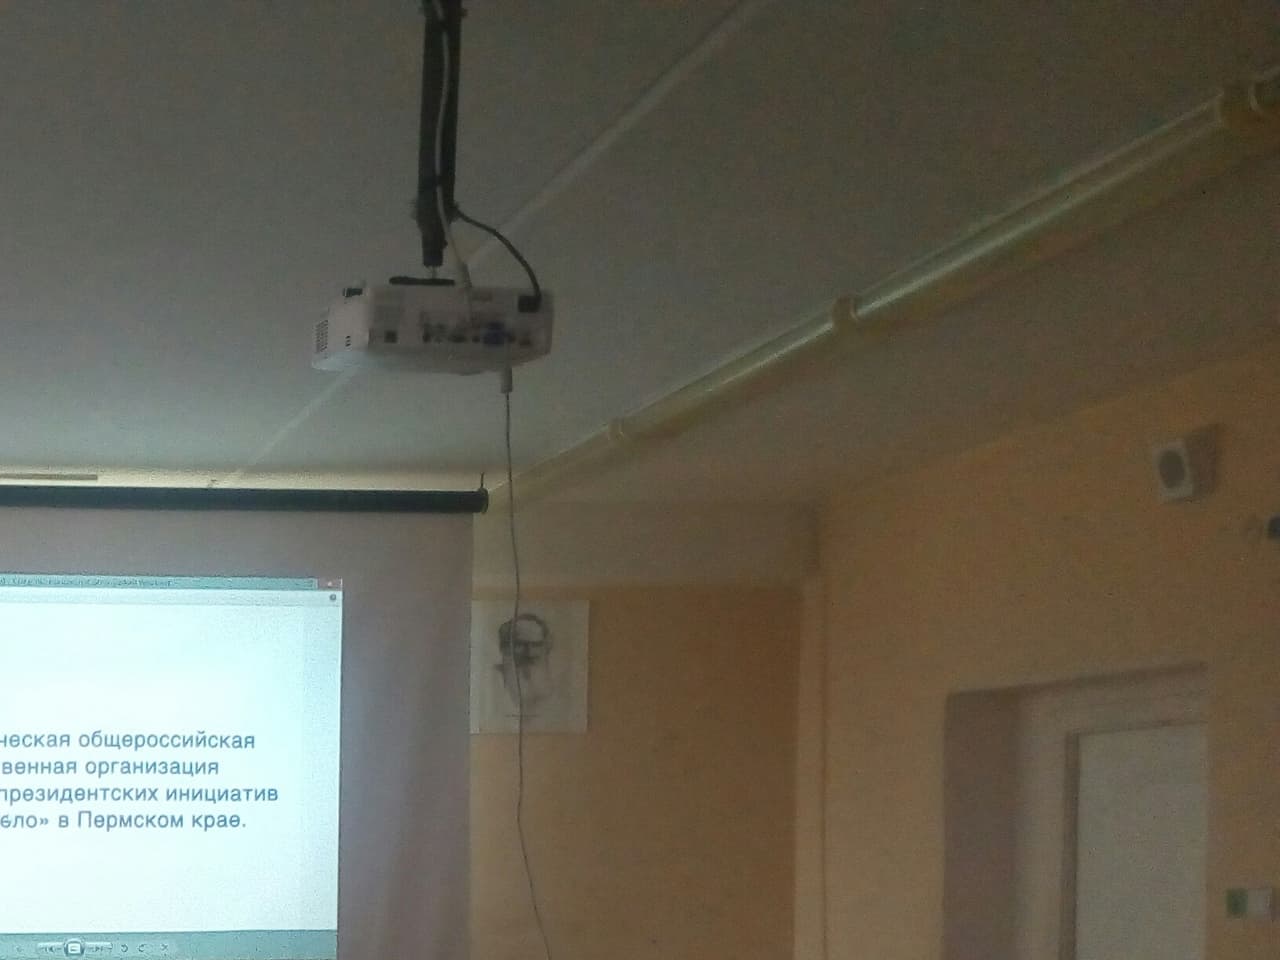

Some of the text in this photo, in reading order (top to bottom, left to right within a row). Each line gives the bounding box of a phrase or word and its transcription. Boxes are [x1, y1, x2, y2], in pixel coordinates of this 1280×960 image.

[78, 729, 256, 751] общероссийская
[85, 760, 220, 778] организация
[166, 788, 279, 804] инициатив
[58, 814, 70, 828] в
[77, 810, 184, 832] Пермском
[191, 814, 247, 832] крае.
